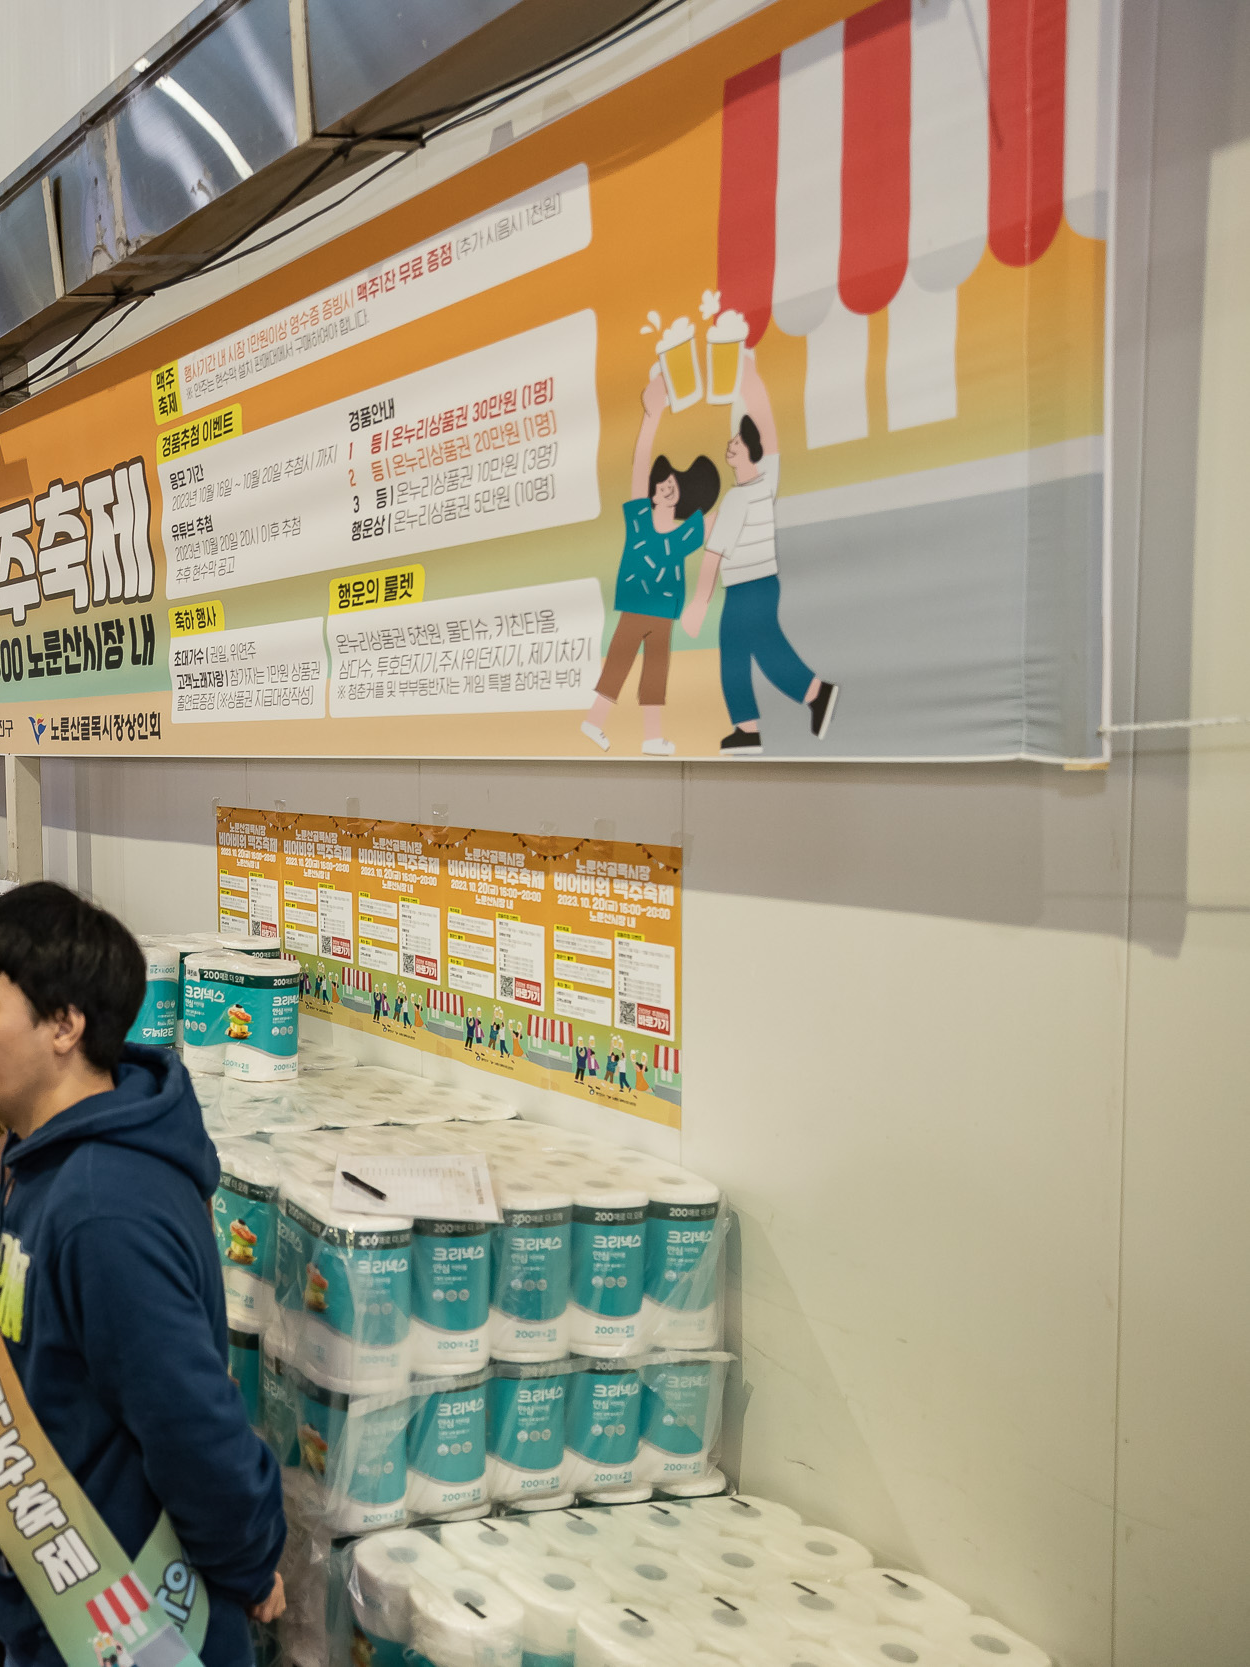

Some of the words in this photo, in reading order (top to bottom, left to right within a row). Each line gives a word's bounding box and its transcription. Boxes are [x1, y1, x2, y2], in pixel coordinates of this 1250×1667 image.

[184, 355, 216, 383] 행사기간
[218, 353, 227, 370] 내
[228, 343, 245, 366] 시장
[247, 323, 287, 353] 1만원이상
[290, 305, 320, 334] 영수증
[322, 292, 354, 319] 증빙시
[357, 268, 396, 303] 맥주1잔
[399, 255, 423, 285] 무료
[427, 242, 453, 273] 증정
[486, 211, 522, 244] 시음시
[194, 377, 215, 399] 안주는
[215, 369, 238, 390] 현수막
[238, 361, 253, 380] 설치
[254, 343, 293, 372] 판매대에서
[295, 327, 338, 354] 구매하여야
[340, 308, 370, 336] 합니다.
[156, 367, 175, 391] 맥주
[158, 391, 178, 416] 축제
[349, 398, 395, 432] 경품안내
[370, 432, 382, 455] 등
[391, 404, 469, 449] 온누리상품권
[472, 388, 517, 423] 30만원
[522, 377, 554, 411] (1명)
[162, 424, 200, 458] 경품추첨
[202, 411, 234, 442] 이벤트
[348, 468, 357, 487] 2
[370, 460, 384, 482] 등
[392, 436, 471, 477] 온누리상품권
[474, 420, 521, 453] 20만원
[523, 409, 558, 442] (1명)
[170, 472, 186, 490] 응모
[187, 464, 204, 485] 기간
[172, 487, 197, 511] 2023년
[199, 482, 215, 503] 10월
[216, 477, 233, 498] 16일
[243, 469, 260, 490] 10월
[262, 462, 283, 485] 20일
[284, 451, 314, 478] 추첨시
[316, 444, 338, 468] 까지
[353, 495, 360, 513] 3
[376, 487, 388, 510] 등
[396, 465, 473, 505] 온누리상품권
[477, 452, 519, 483] 10만원
[522, 441, 558, 475] (3명)
[351, 516, 386, 542] 행운상
[393, 493, 471, 533] 온누리상품권
[474, 485, 510, 514] 5만원
[515, 474, 556, 507] (10명)
[172, 520, 196, 542] 유튜브
[196, 514, 214, 534] 추첨
[175, 538, 201, 562] 2023년
[201, 534, 218, 556] 10월
[220, 532, 238, 552] 20일
[240, 526, 259, 548] 20시
[261, 521, 280, 543] 이후
[282, 516, 301, 537] 추첨
[176, 564, 191, 584] 추후
[193, 559, 217, 582] 현수막
[218, 556, 236, 577] 공고
[337, 577, 379, 610] 행운의
[384, 572, 414, 602] 룰렛
[175, 607, 195, 631] 축하
[196, 606, 217, 628] 행사
[335, 625, 406, 655] 온누리상품권
[408, 623, 445, 647] 5천원,
[446, 616, 492, 643] 물티슈,
[495, 609, 559, 637] 키친타올,
[27, 618, 125, 679] 노룬산시장
[131, 613, 156, 667] 내
[174, 649, 204, 667] 초대가수
[230, 641, 256, 661] 위연주
[339, 660, 373, 680] 삼다수,
[528, 637, 592, 664] 제기차기
[177, 670, 224, 690] 고객노래자랑
[230, 668, 265, 687] 참가자는
[267, 664, 289, 684] 1만원
[292, 660, 321, 682] 상품권
[348, 680, 384, 702] 청춘커플
[387, 679, 397, 698] 및
[399, 677, 460, 698] 부부동반자는
[463, 674, 485, 695] 게임
[488, 673, 511, 693] 특별
[515, 670, 552, 691] 참여권
[555, 668, 582, 688] 부여
[177, 693, 216, 712] 출연료증정
[50, 711, 162, 742] 노룬산골목시장상인회
[397, 854, 440, 875] 맥주축제
[464, 848, 526, 868] 노룬산골목시장
[575, 859, 651, 882] 노룬산골목시장
[447, 860, 493, 883] 비어비워
[495, 864, 545, 890] 맥주축제
[553, 872, 610, 897] 비어비워
[613, 880, 675, 907] 맥주축제
[557, 895, 579, 907] 2023.
[589, 910, 626, 927] 노룬산시장
[627, 916, 636, 928] 내
[203, 970, 229, 982] 200매로
[185, 985, 226, 1003] 크리넥스
[515, 987, 541, 1003] 바로가기
[637, 1014, 670, 1032] 바로가기
